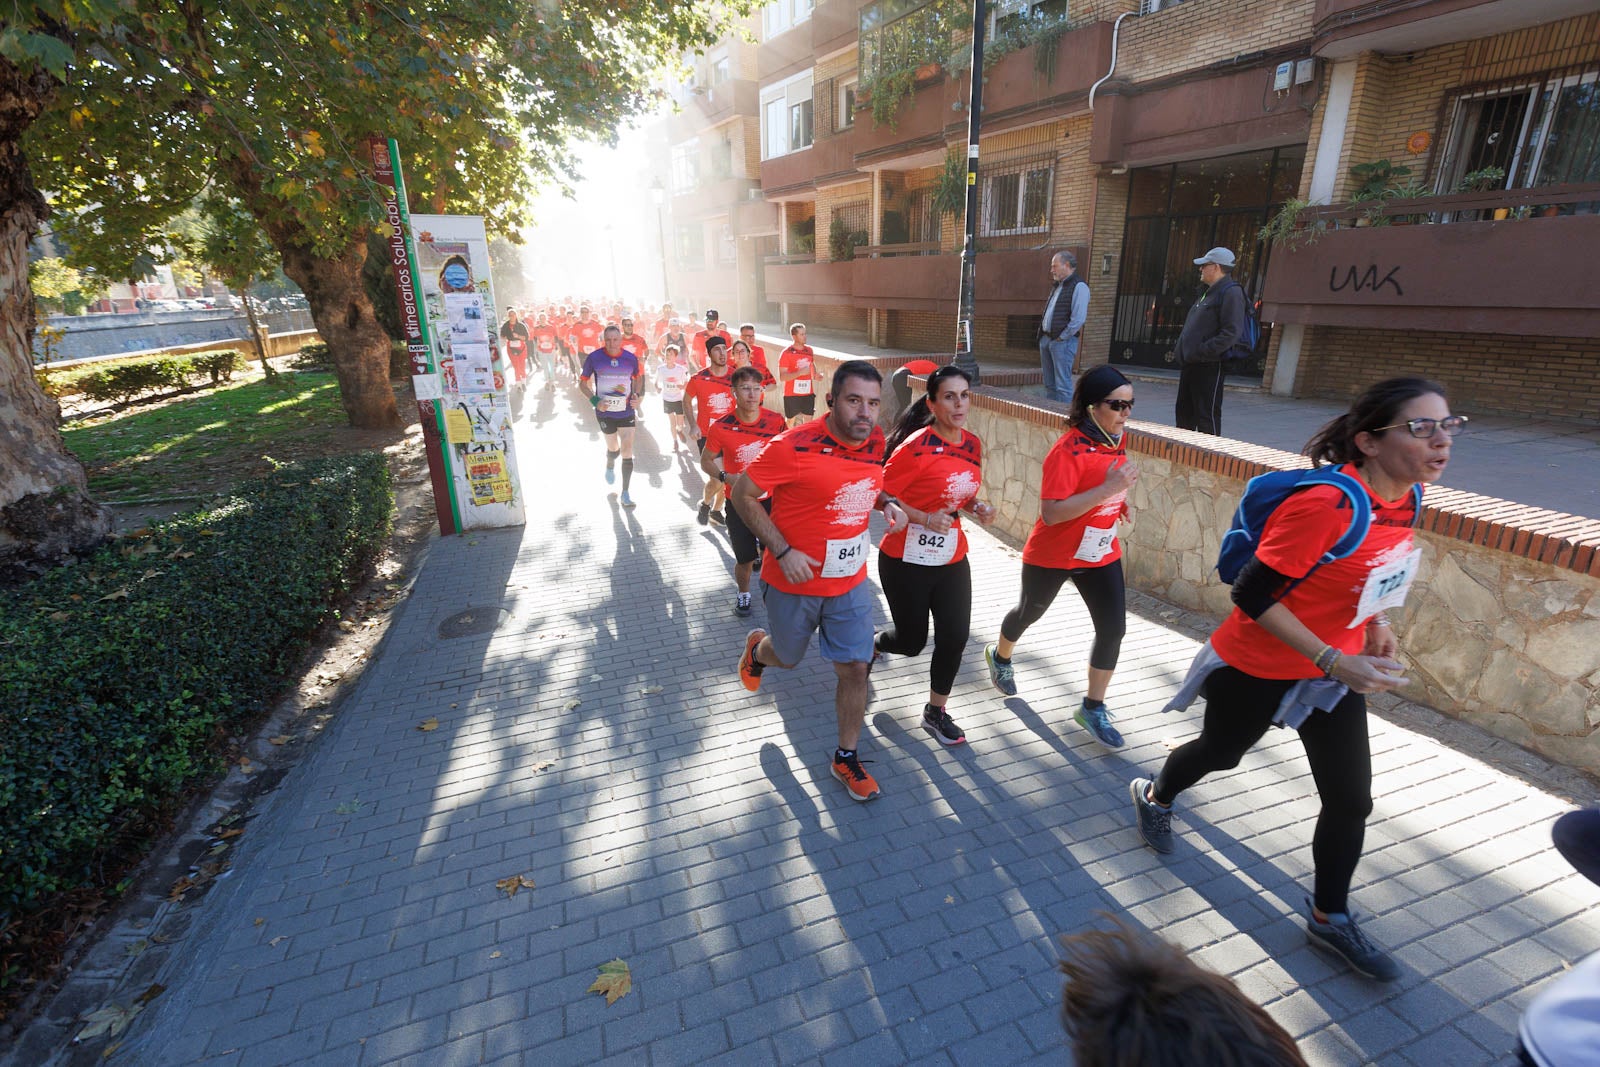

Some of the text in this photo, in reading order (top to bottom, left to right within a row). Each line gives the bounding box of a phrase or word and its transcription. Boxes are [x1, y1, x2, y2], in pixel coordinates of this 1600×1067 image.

[1212, 192, 1221, 207] 2
[918, 534, 945, 548] 842
[838, 544, 861, 560] 841
